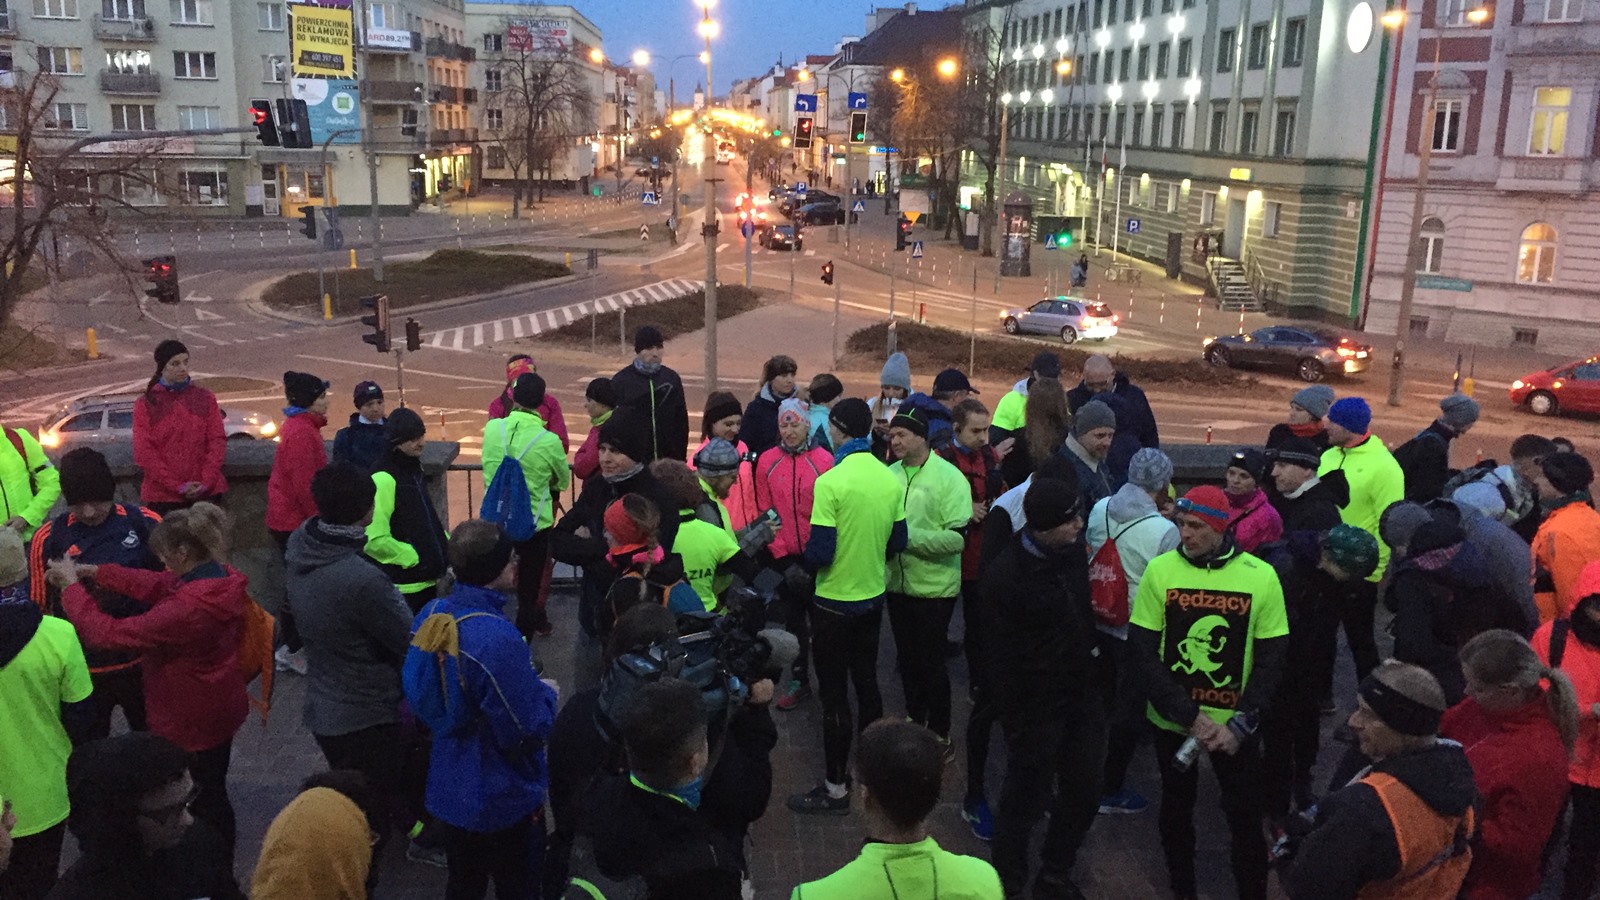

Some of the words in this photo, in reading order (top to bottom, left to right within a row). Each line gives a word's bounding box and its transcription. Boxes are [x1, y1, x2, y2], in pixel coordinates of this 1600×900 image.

[297, 16, 349, 29] POWIERZCHNIA
[297, 25, 349, 37] REKLAMOWA
[685, 568, 712, 580] ZIA
[1166, 589, 1251, 615] Pędzący
[1192, 687, 1239, 708] nocy
